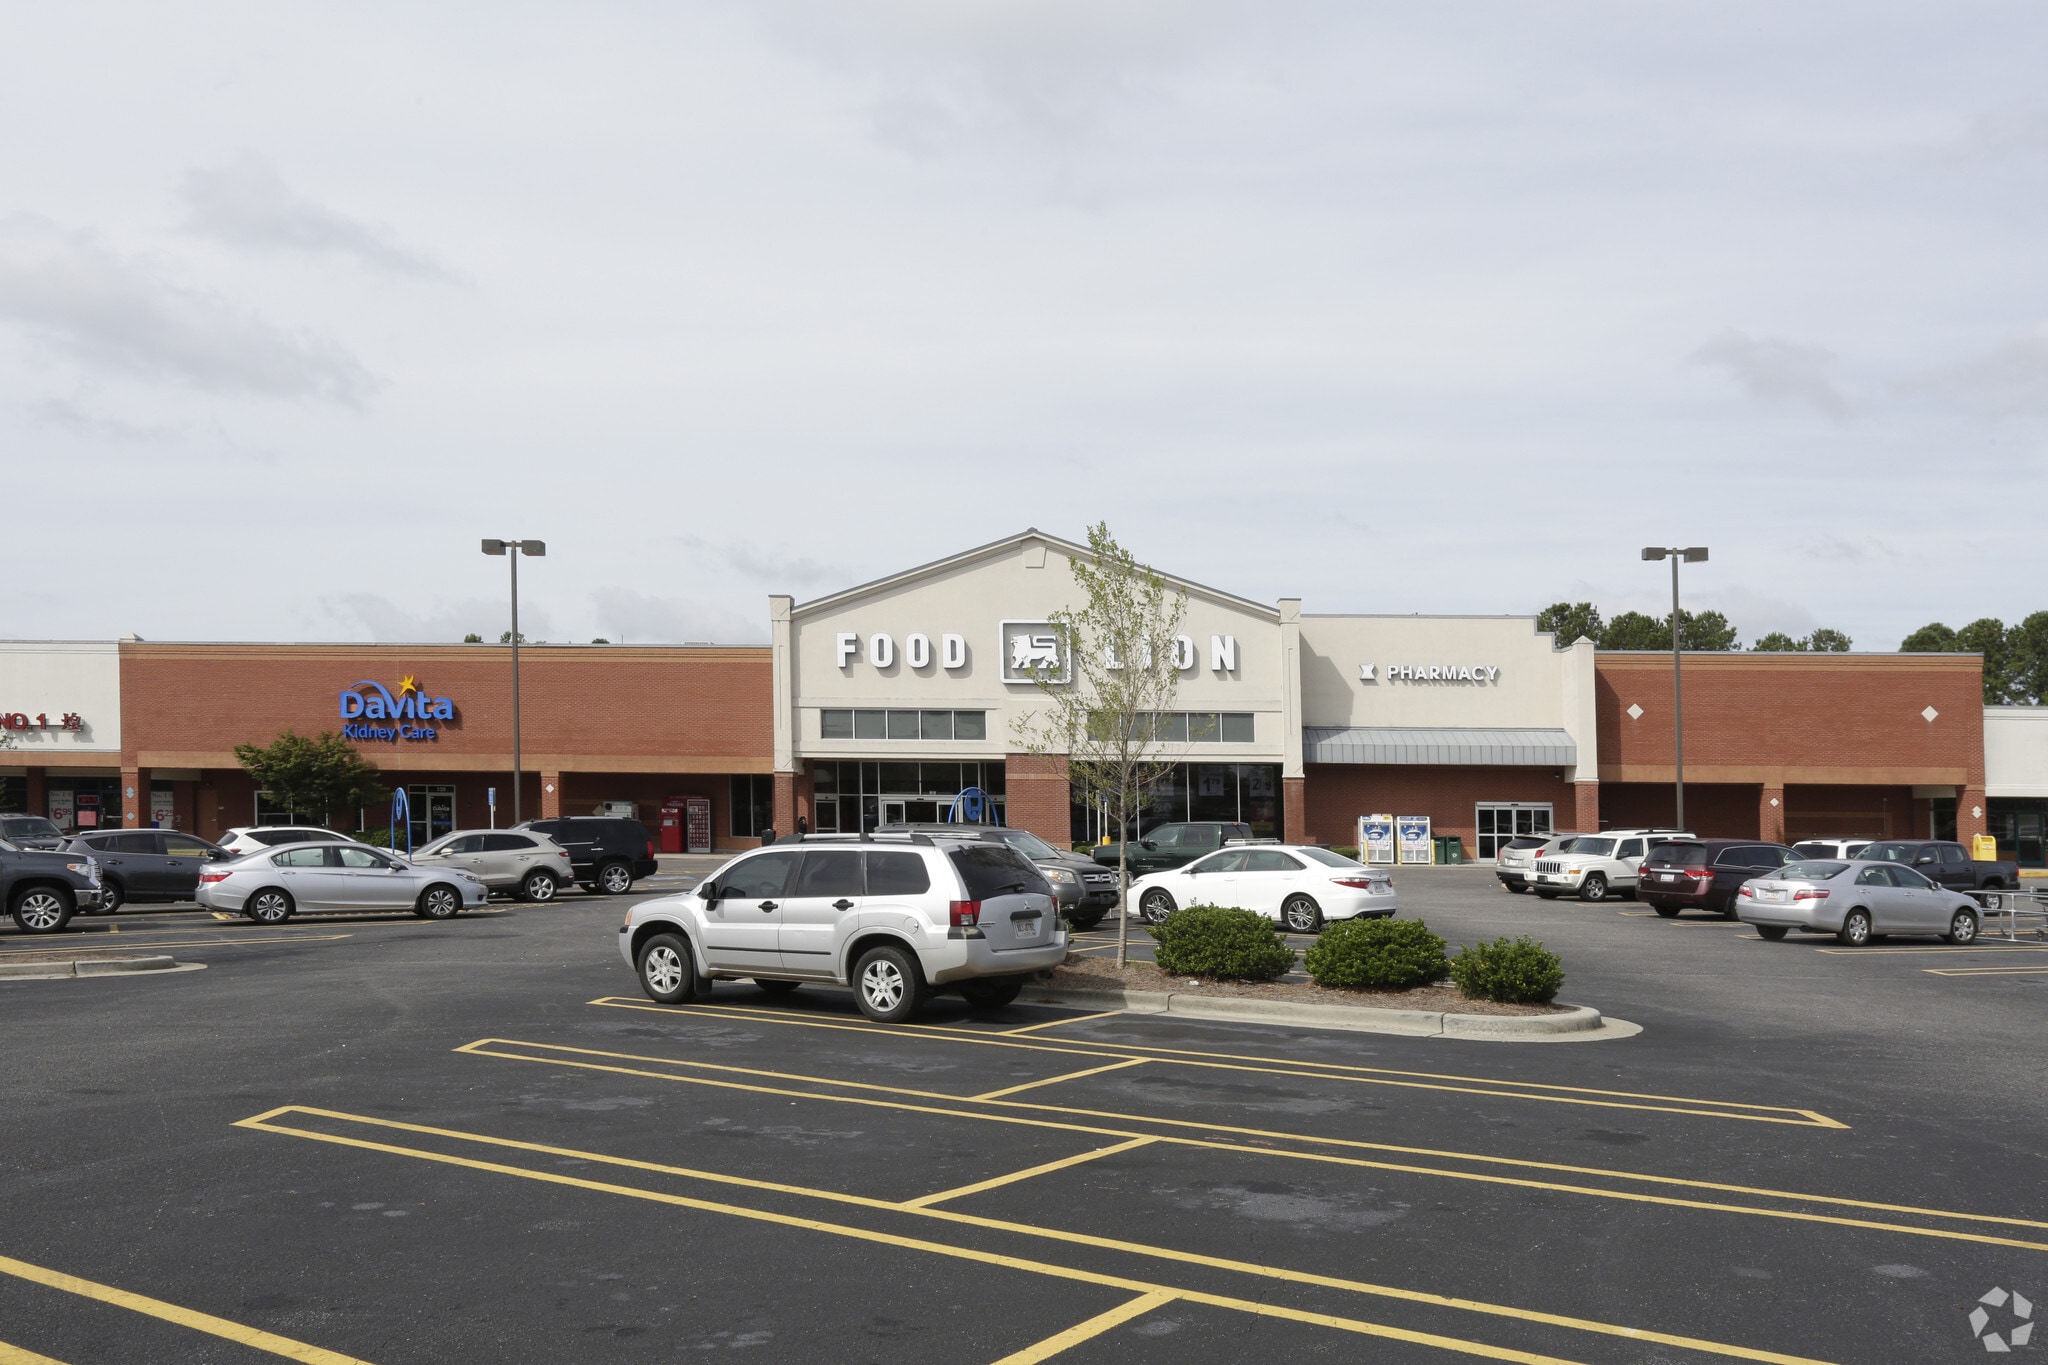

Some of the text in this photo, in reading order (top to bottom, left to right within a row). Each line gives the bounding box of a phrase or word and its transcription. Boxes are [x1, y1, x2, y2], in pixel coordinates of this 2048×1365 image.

[836, 632, 1235, 671] FOOD LION
[1387, 665, 1498, 680] PHARMACY
[339, 680, 454, 720] DaVita
[0, 713, 32, 731] NO.
[36, 713, 47, 730] 1
[343, 724, 436, 741] Kidney Care
